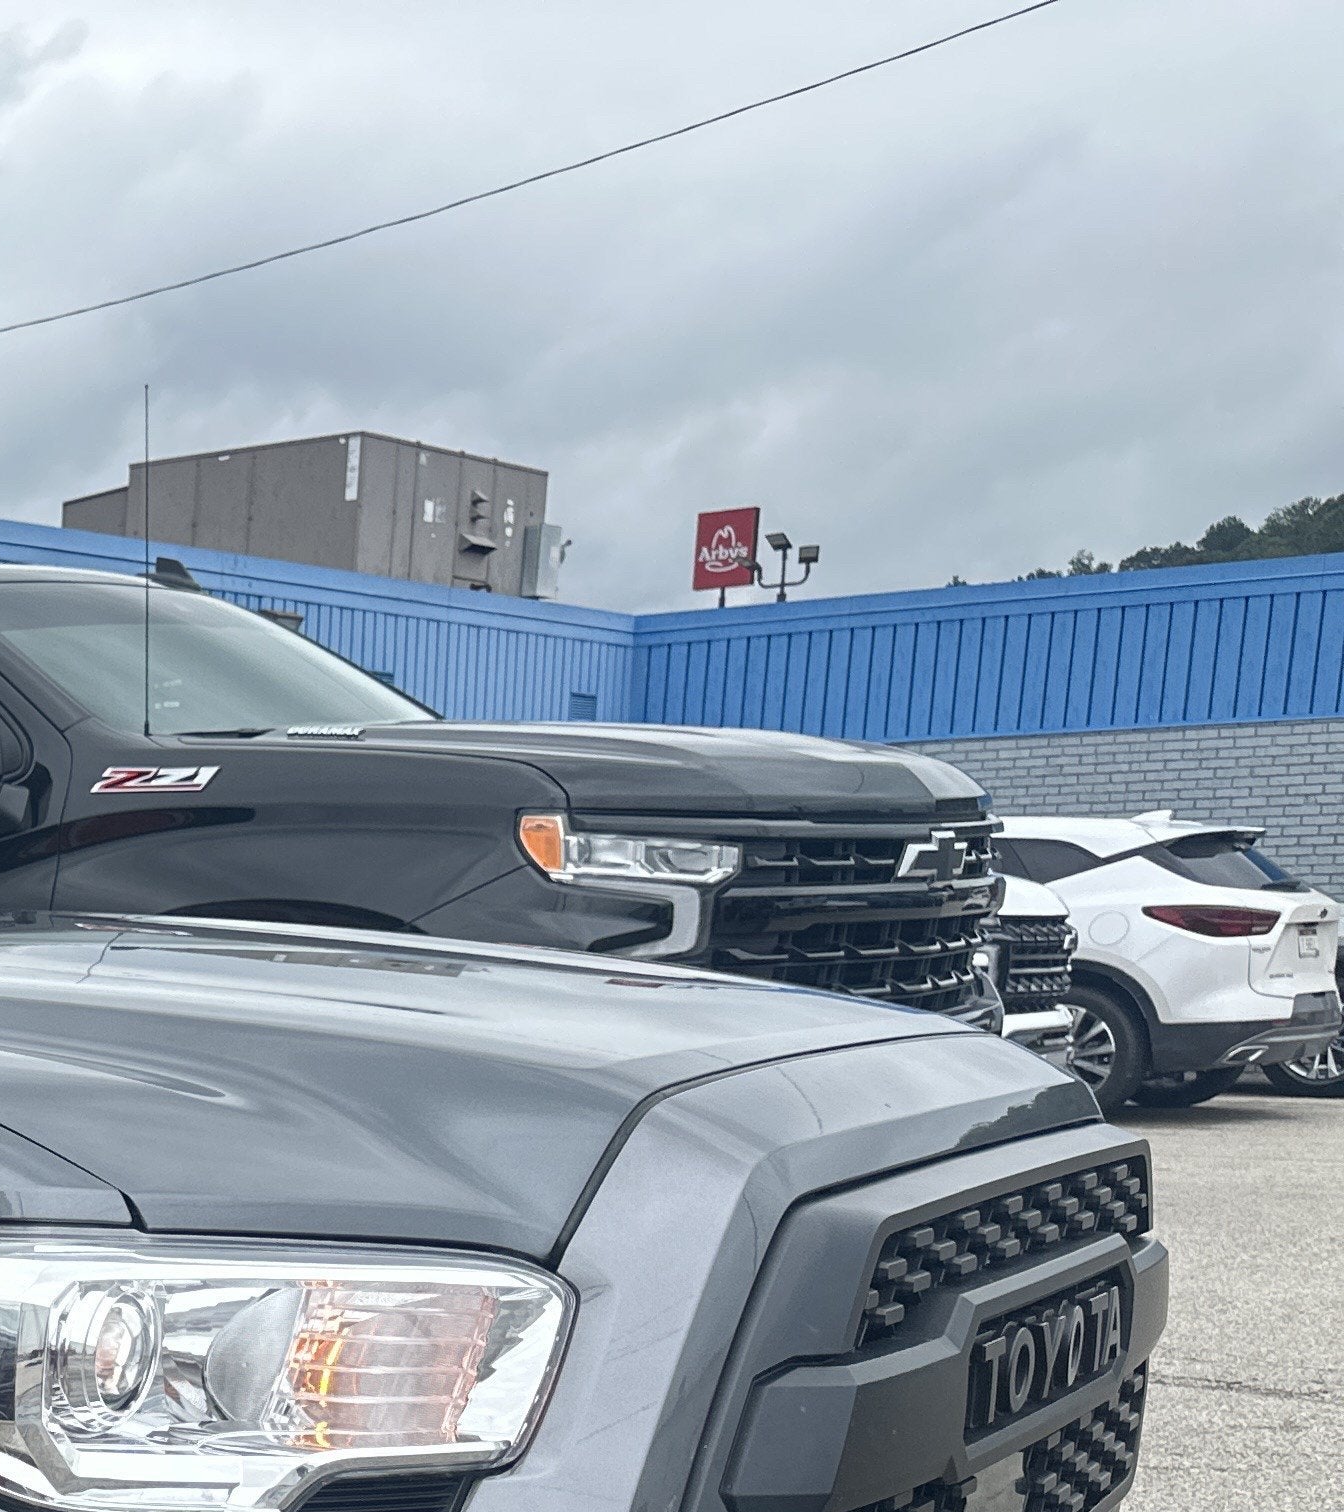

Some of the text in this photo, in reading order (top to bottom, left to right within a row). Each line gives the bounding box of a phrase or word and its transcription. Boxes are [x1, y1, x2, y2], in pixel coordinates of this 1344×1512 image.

[698, 542, 748, 563] Arby's
[90, 766, 221, 793] Z71
[983, 1286, 1121, 1424] TOYOTA
